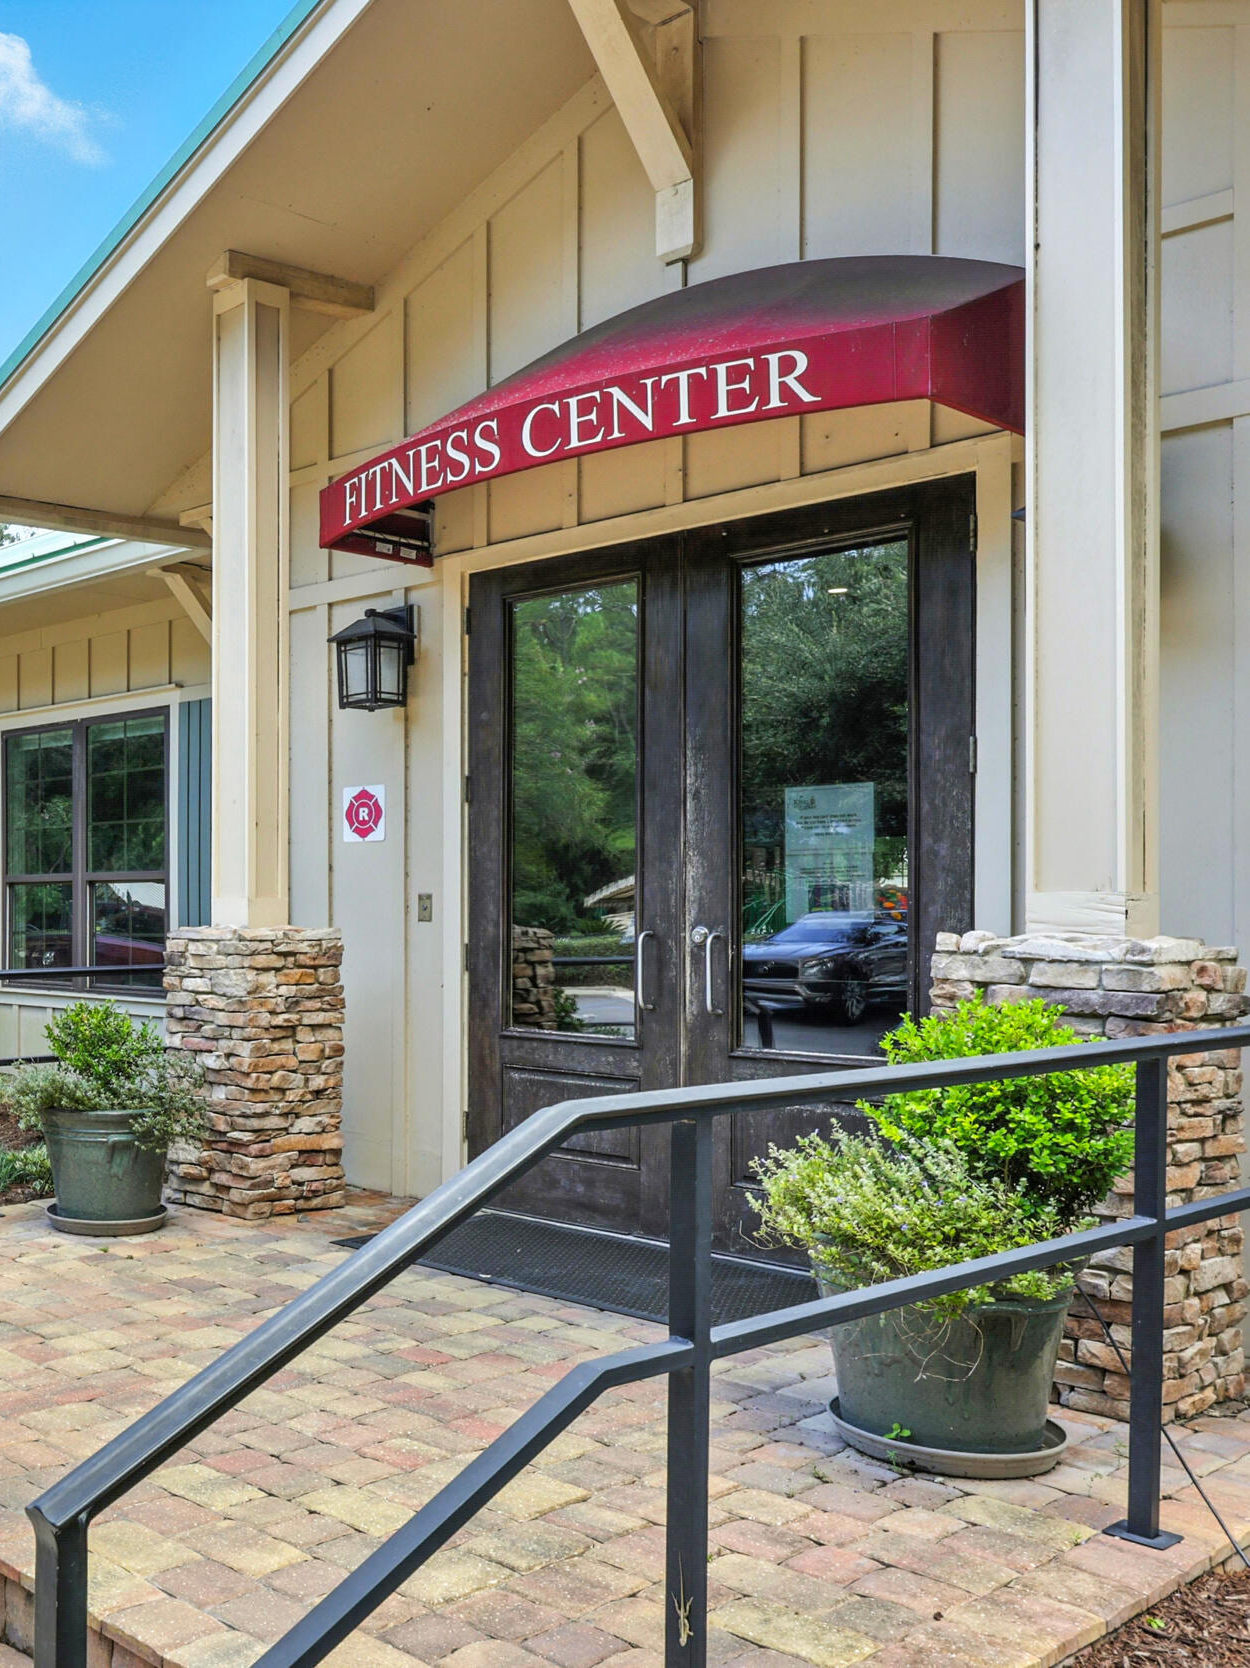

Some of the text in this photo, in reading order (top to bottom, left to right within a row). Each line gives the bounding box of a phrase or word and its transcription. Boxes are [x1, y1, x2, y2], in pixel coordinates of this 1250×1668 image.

[343, 349, 822, 527] FITNESS CENTER
[359, 807, 369, 821] R
